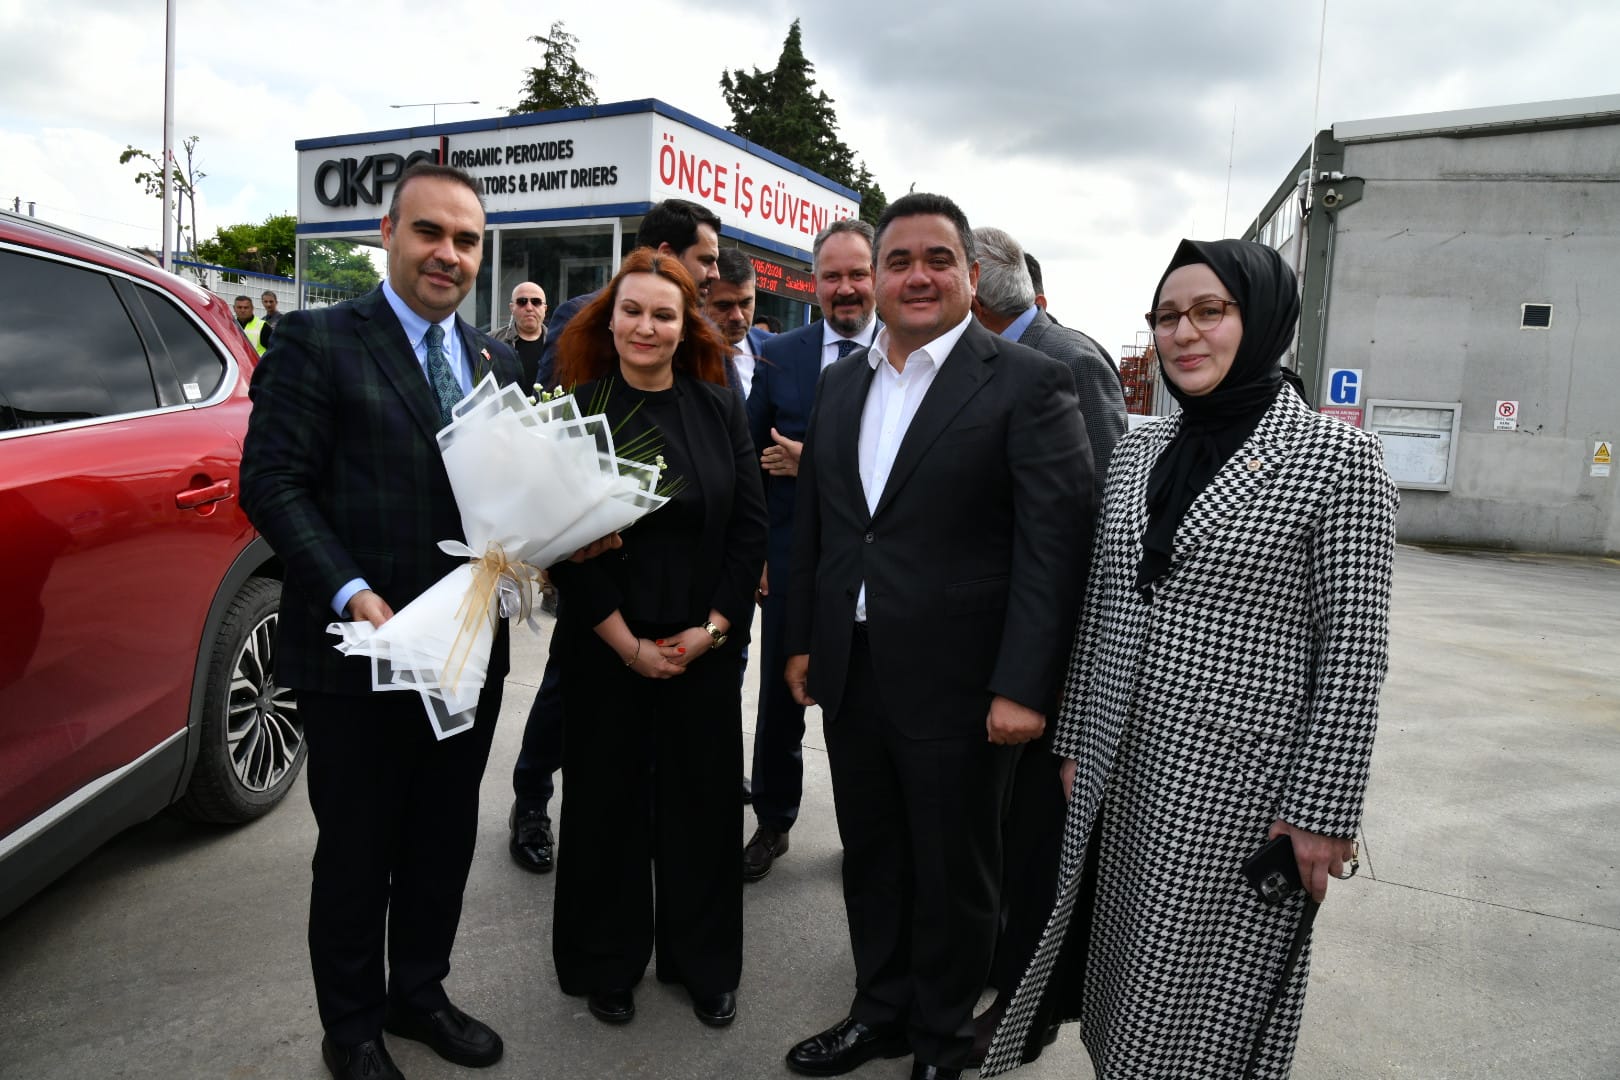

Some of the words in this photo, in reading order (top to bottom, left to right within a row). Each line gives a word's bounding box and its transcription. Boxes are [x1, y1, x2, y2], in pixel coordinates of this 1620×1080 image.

[451, 146, 502, 168] ORGANIC
[505, 139, 574, 165] PEROXIDES
[518, 174, 527, 193] &
[530, 169, 569, 192] PAINT
[570, 165, 618, 188] DRIERS
[659, 132, 728, 205] ÖNCE
[734, 162, 754, 218] İŞ
[1330, 370, 1358, 404] G
